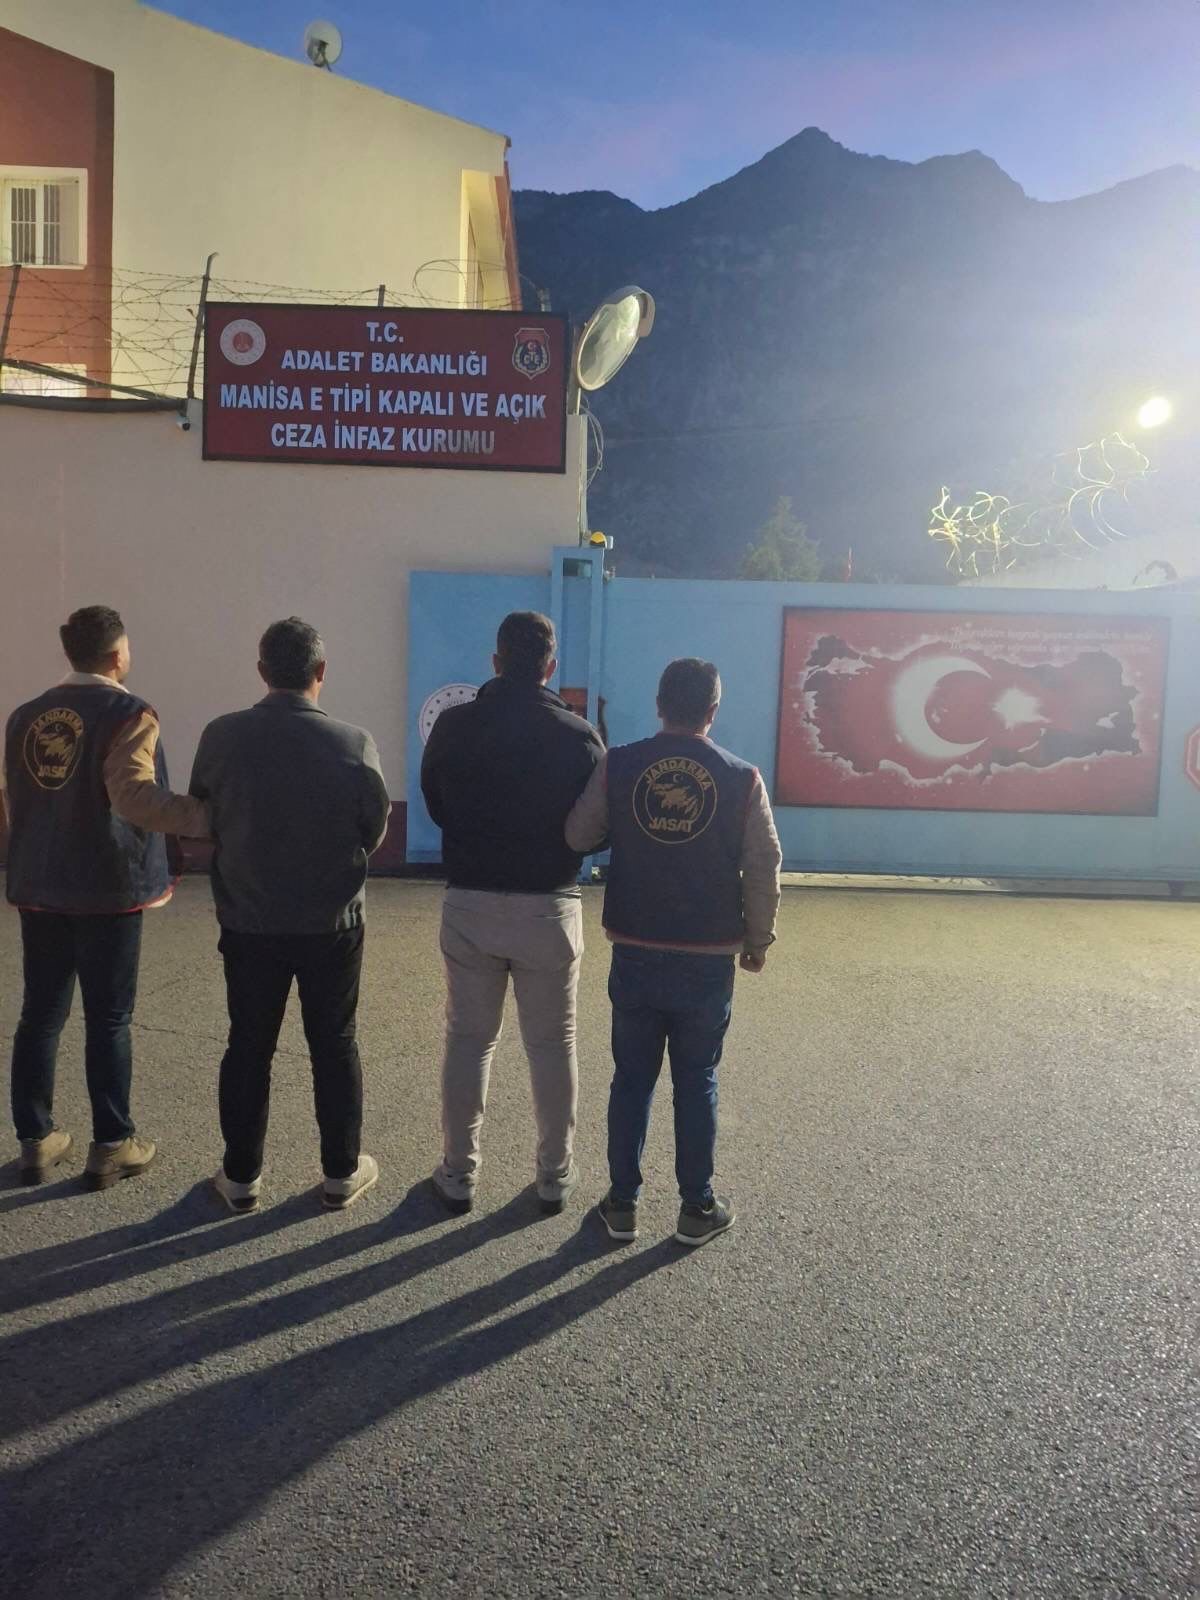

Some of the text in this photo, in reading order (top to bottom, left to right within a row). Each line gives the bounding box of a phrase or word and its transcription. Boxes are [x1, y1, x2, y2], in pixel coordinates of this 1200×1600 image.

[366, 322, 404, 342] T.C.
[281, 350, 487, 376] ADALET BAKANLIĞI
[220, 380, 547, 424] MANİSA E TİPİ KAPALI VE AÇIK
[271, 419, 495, 455] CEZA İNFAZ KURUMU
[644, 760, 713, 791] JANDARMA
[648, 817, 693, 833] JASAT
